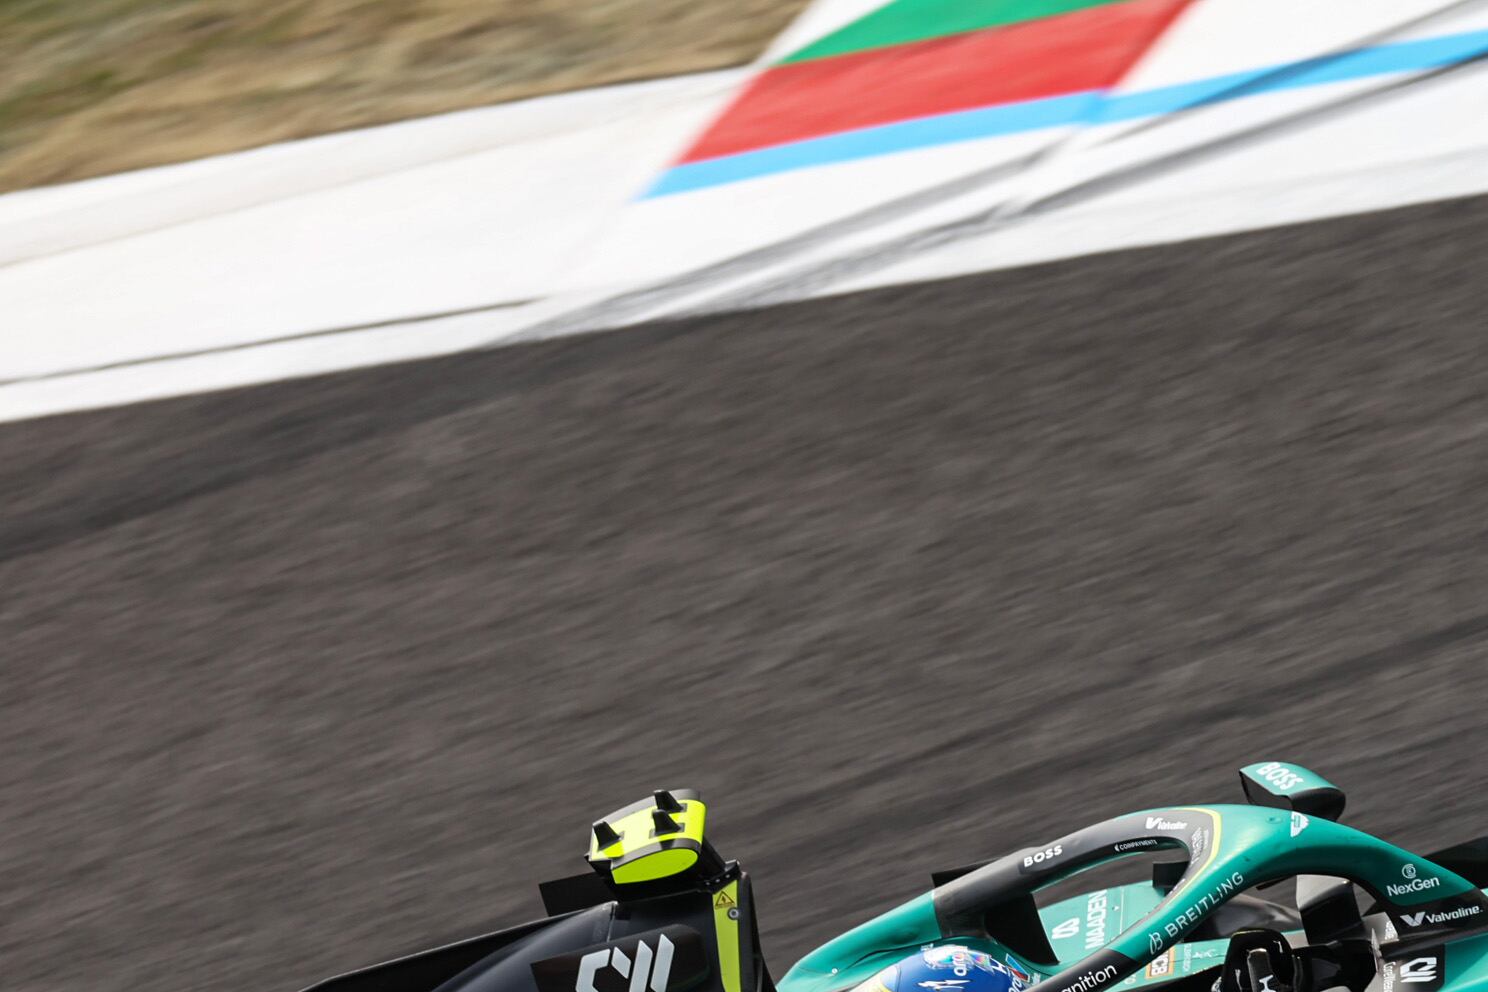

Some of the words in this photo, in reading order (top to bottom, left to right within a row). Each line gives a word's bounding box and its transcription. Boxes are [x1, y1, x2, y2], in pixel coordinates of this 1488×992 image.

[1256, 762, 1304, 790] BOSS
[1024, 845, 1063, 868] BOSS
[1387, 876, 1440, 897] NexGen
[1165, 871, 1244, 936] BREITLING
[1426, 905, 1481, 924] Valvoline
